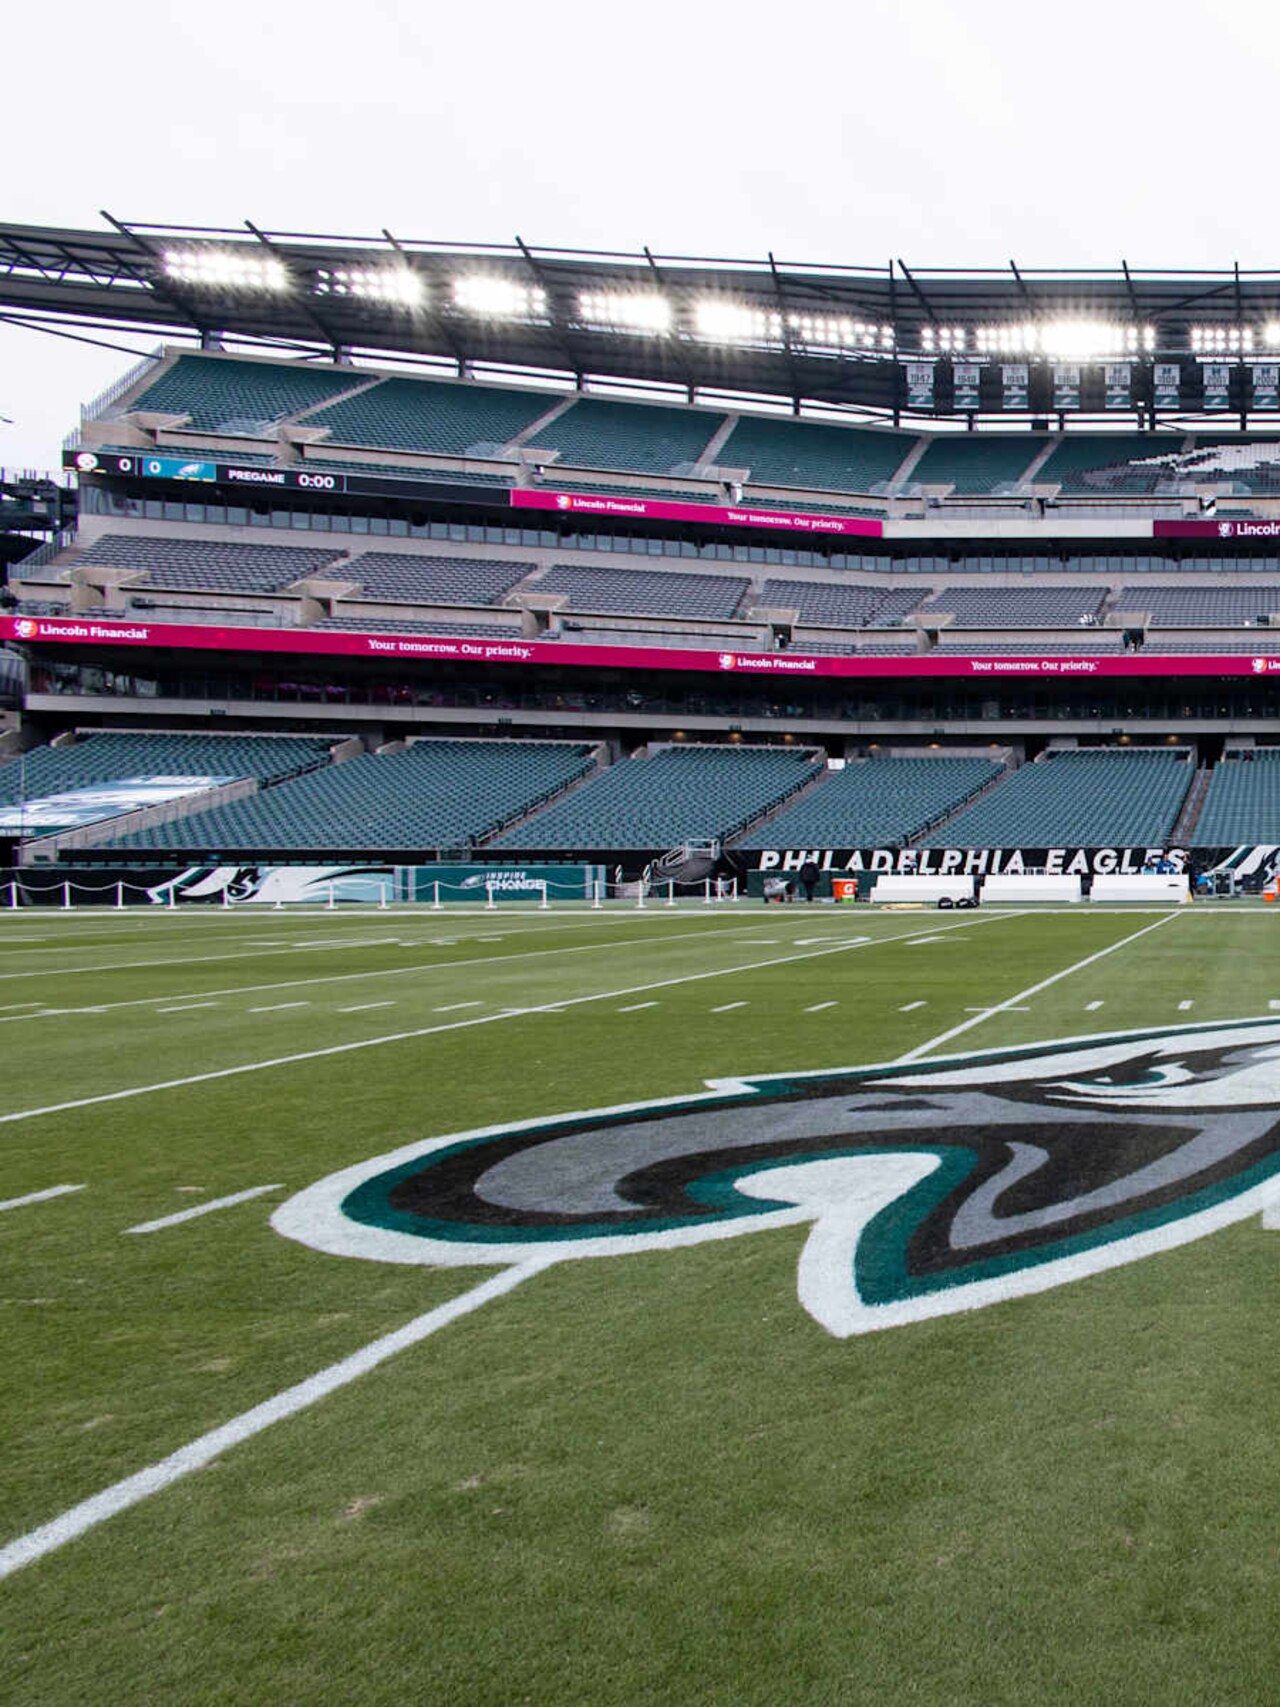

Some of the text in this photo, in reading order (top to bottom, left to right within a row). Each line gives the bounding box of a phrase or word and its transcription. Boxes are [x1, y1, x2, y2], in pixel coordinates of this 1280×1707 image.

[119, 458, 131, 471] 0
[149, 461, 161, 474] 0
[228, 469, 285, 484] PREGAME
[298, 474, 335, 489] 0:00
[573, 499, 645, 512] Lincoln Financial
[794, 518, 810, 526] Our
[812, 520, 843, 530] priority.
[39, 625, 147, 640] Lincoln Financial
[368, 639, 531, 658] Your tomorrow. Our priority.
[737, 657, 815, 670] Lincoln Financial
[971, 661, 1096, 672] Your tomorrow. Our priority.
[758, 849, 1184, 874] PHILADELPHIA EAGLES
